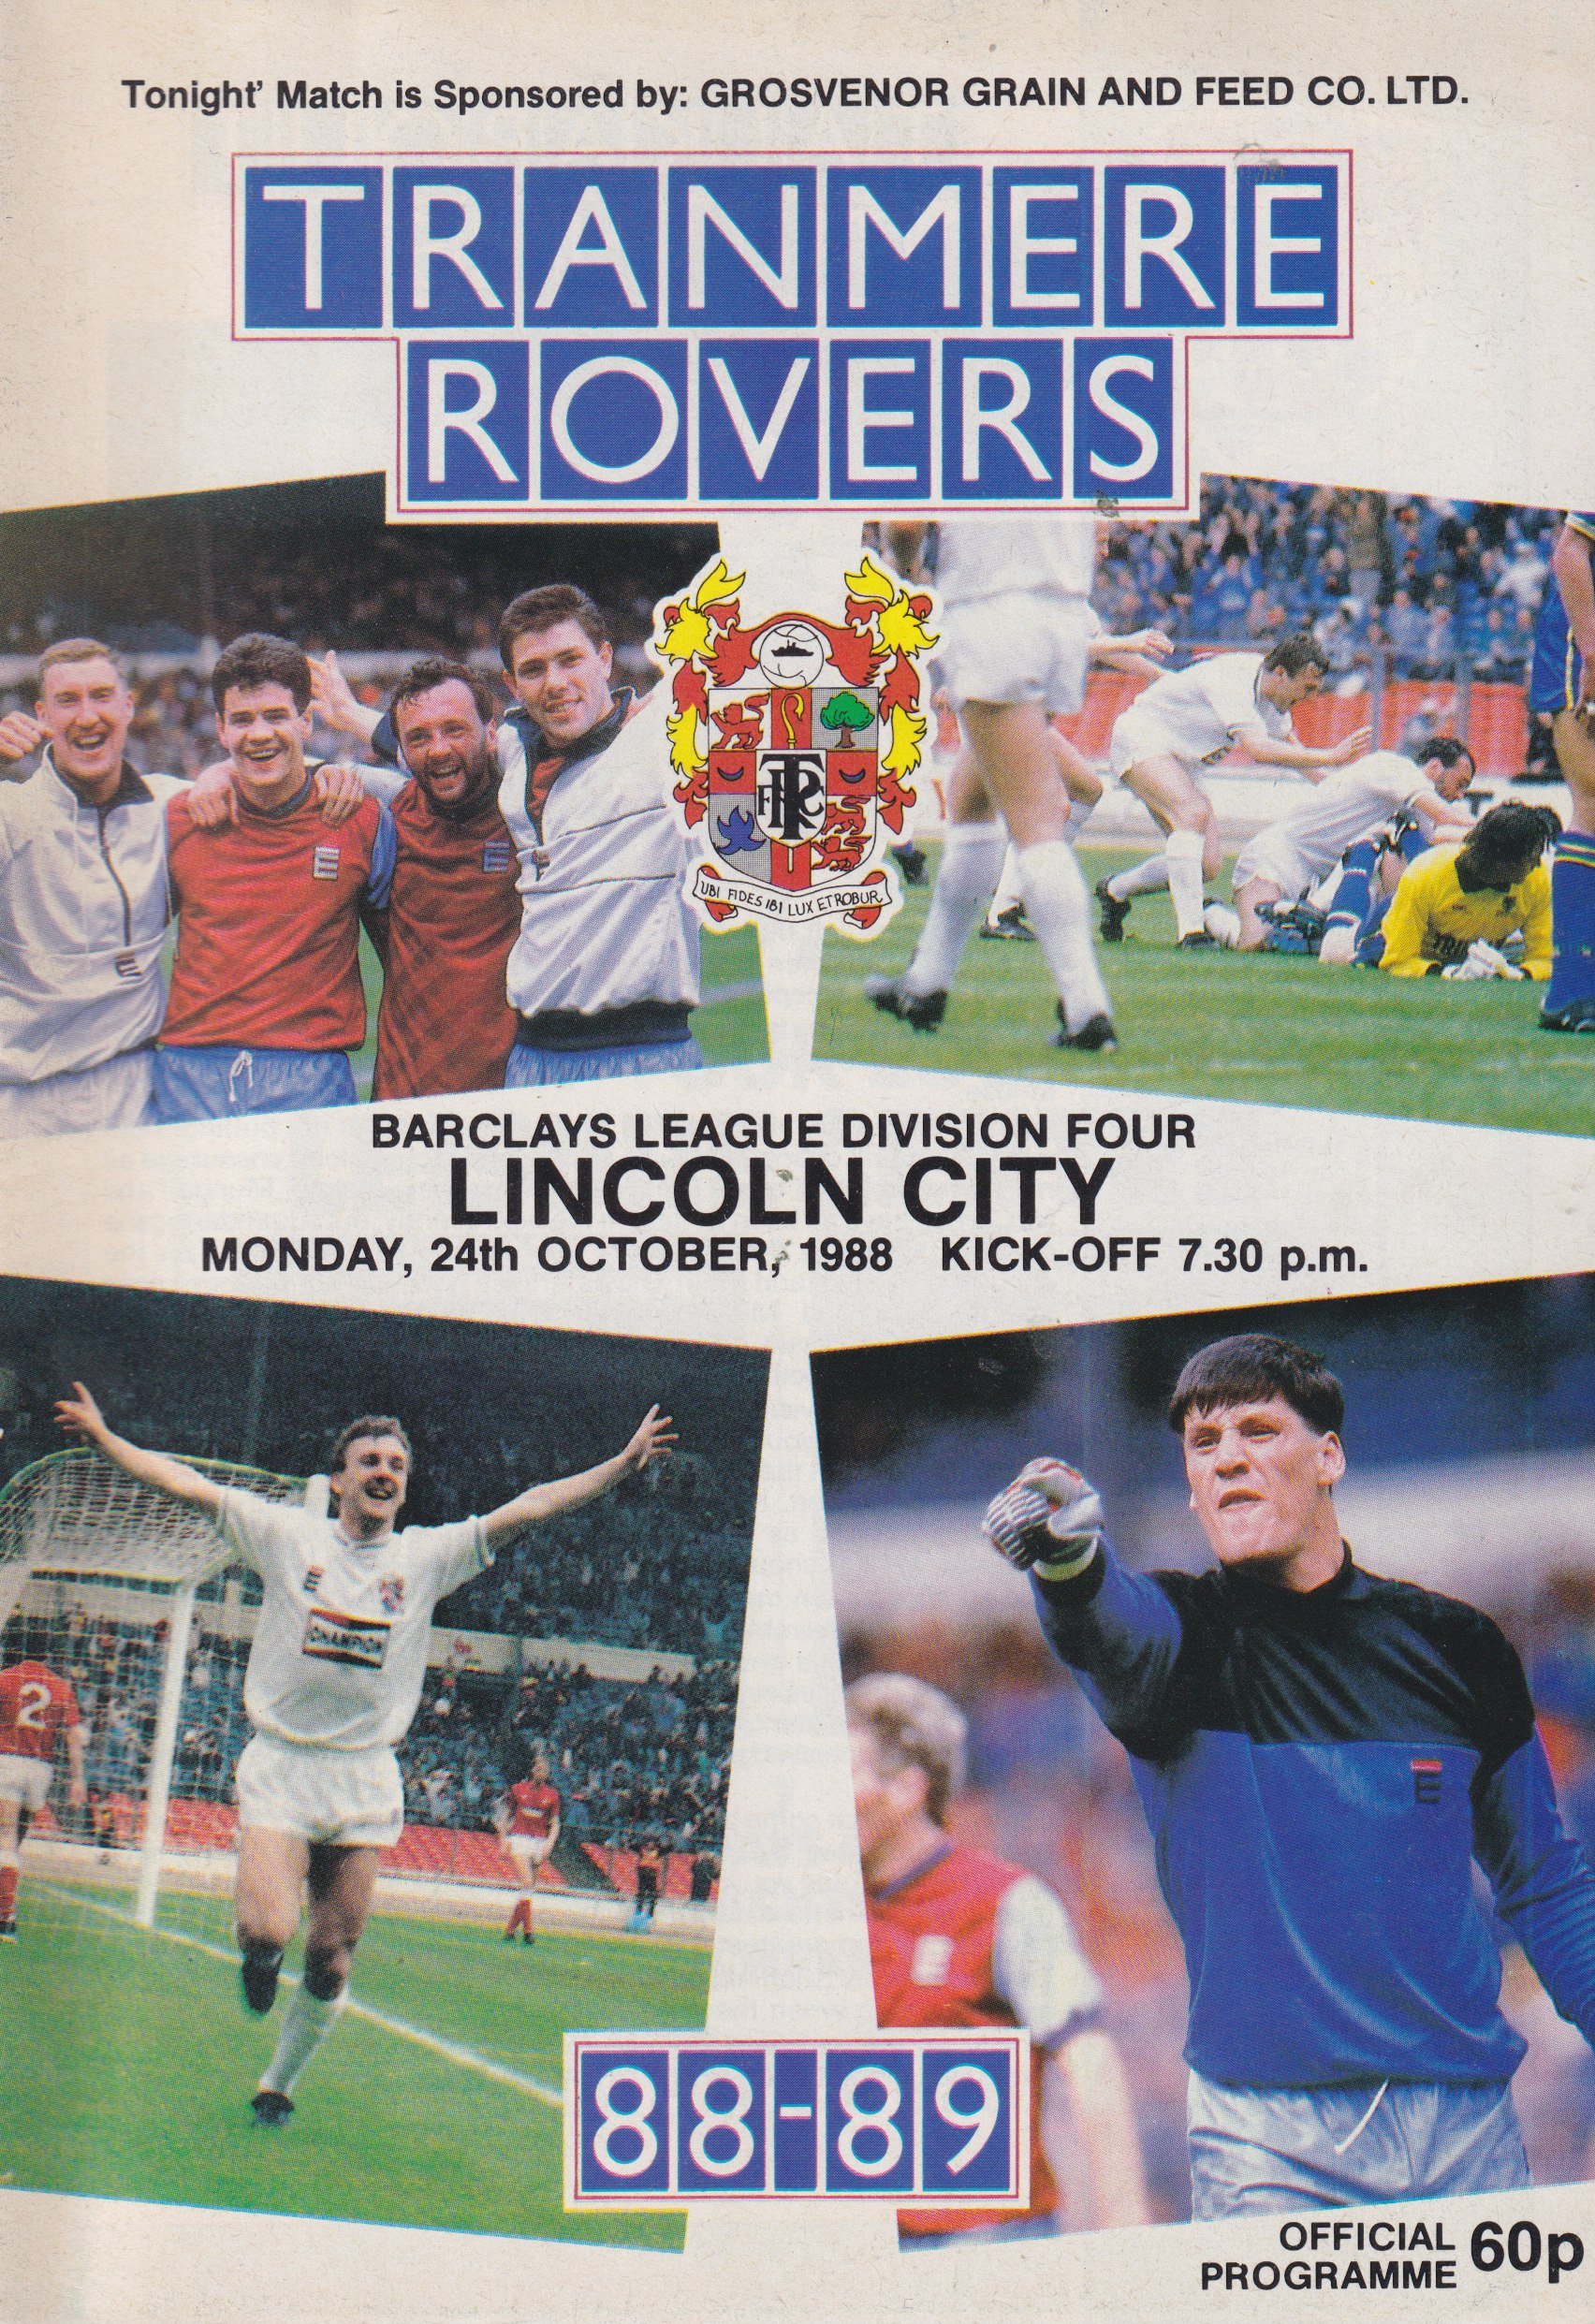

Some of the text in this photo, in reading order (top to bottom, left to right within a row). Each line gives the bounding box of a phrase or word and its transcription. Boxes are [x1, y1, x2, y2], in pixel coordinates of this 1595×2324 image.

[121, 75, 1469, 116] Tonight' Match is Sponsored by: GROSVENOR GRAIN AND FEED CO. LTD.
[263, 183, 1325, 310] TRANMERE
[427, 355, 1159, 485] ROVERS
[701, 880, 720, 899] UBI
[727, 888, 763, 907] FIDES
[788, 899, 813, 916] LUX
[373, 1112, 1196, 1149] BARCLAYS LEAGUE DIVISION FOUR
[450, 1155, 1116, 1227] LINCOLN CITY
[202, 1235, 1368, 1281] MONDAY, 24th OCTOBER, 1988 KICK-OFF 7.30 p.m.
[18, 1682, 51, 1730] 2
[593, 2064, 1000, 2177] 88-89
[1280, 2221, 1456, 2252] OFFICIAL
[1471, 2220, 1585, 2284] 60p
[1201, 2260, 1457, 2291] PROGRAMME
